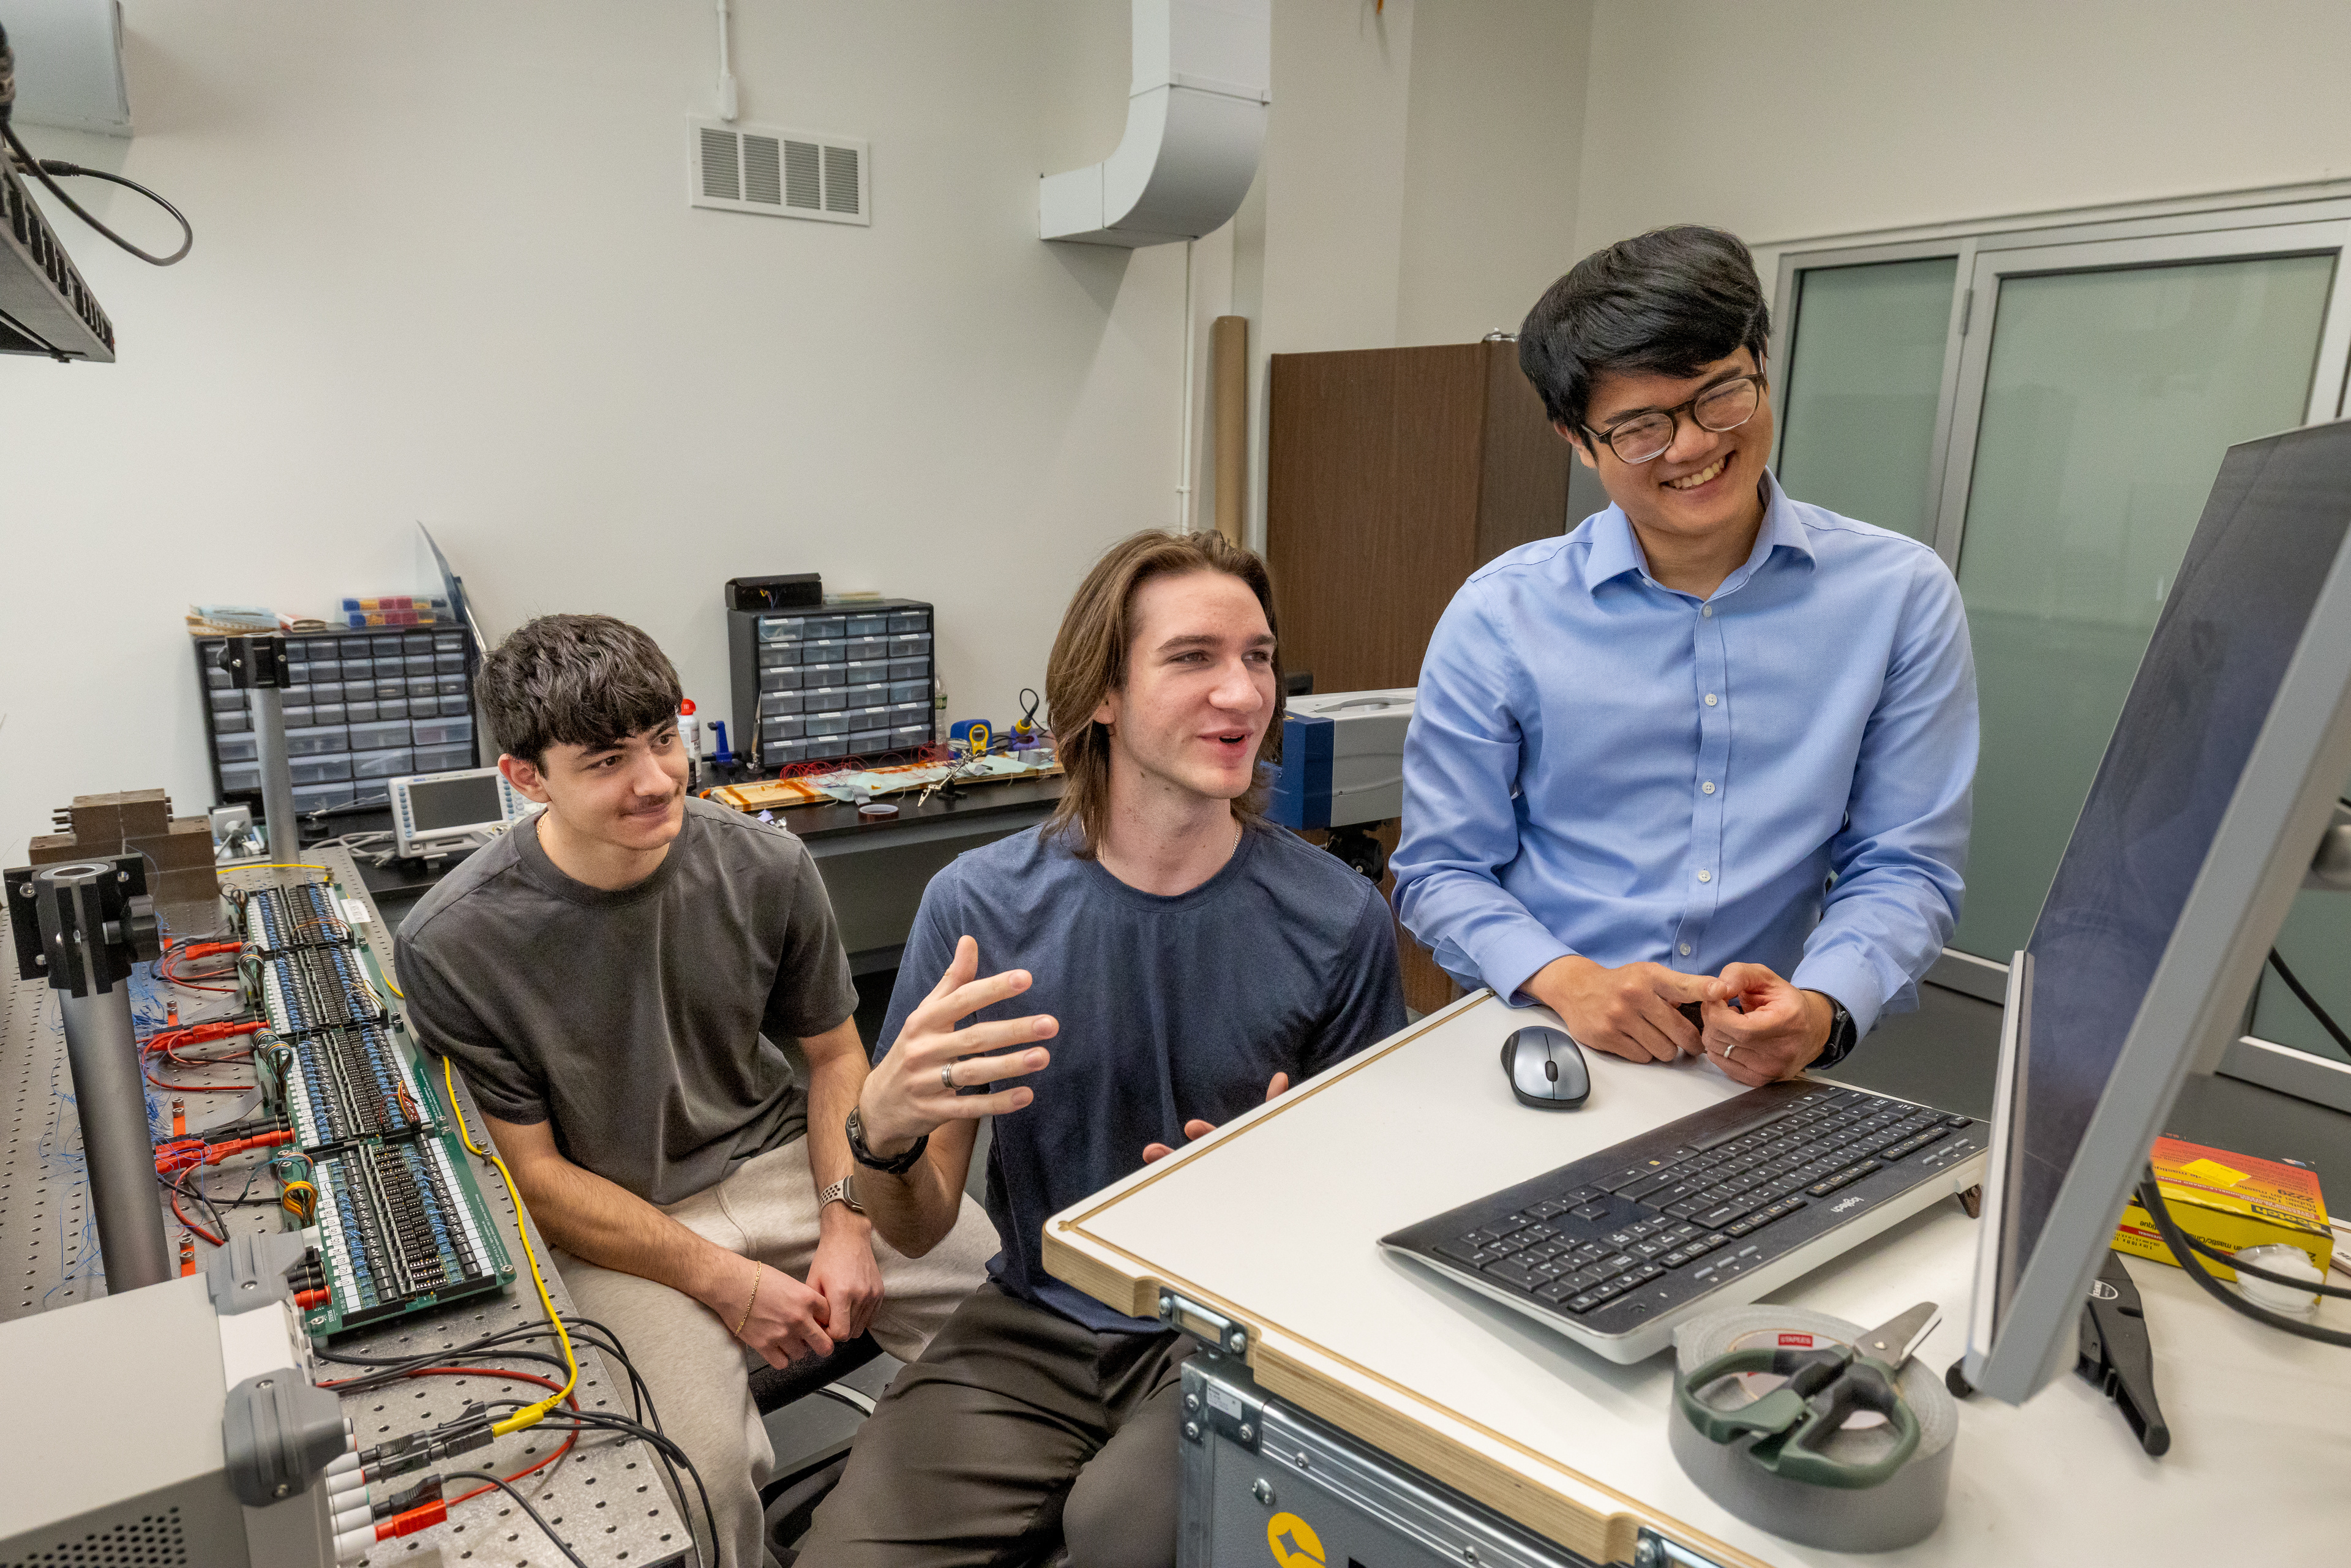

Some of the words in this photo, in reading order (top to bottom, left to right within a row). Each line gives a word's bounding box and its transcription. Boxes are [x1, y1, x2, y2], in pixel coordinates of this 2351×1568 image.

[2154, 1166, 2187, 1175] mastiqu
[2237, 1185, 2267, 1194] mastic
[2260, 1194, 2281, 1202] Tape
[2278, 1189, 2314, 1202] 2229
[1831, 1196, 1864, 1212] logitech
[2285, 1197, 2315, 1208] Ruban
[2285, 1201, 2316, 1213] Mastic
[2255, 1206, 2321, 1230] Scotch
[2140, 1221, 2158, 1231] tique
[2138, 1231, 2164, 1240] OFESIONAL
[2189, 1234, 2231, 1248] mastic/Cin
